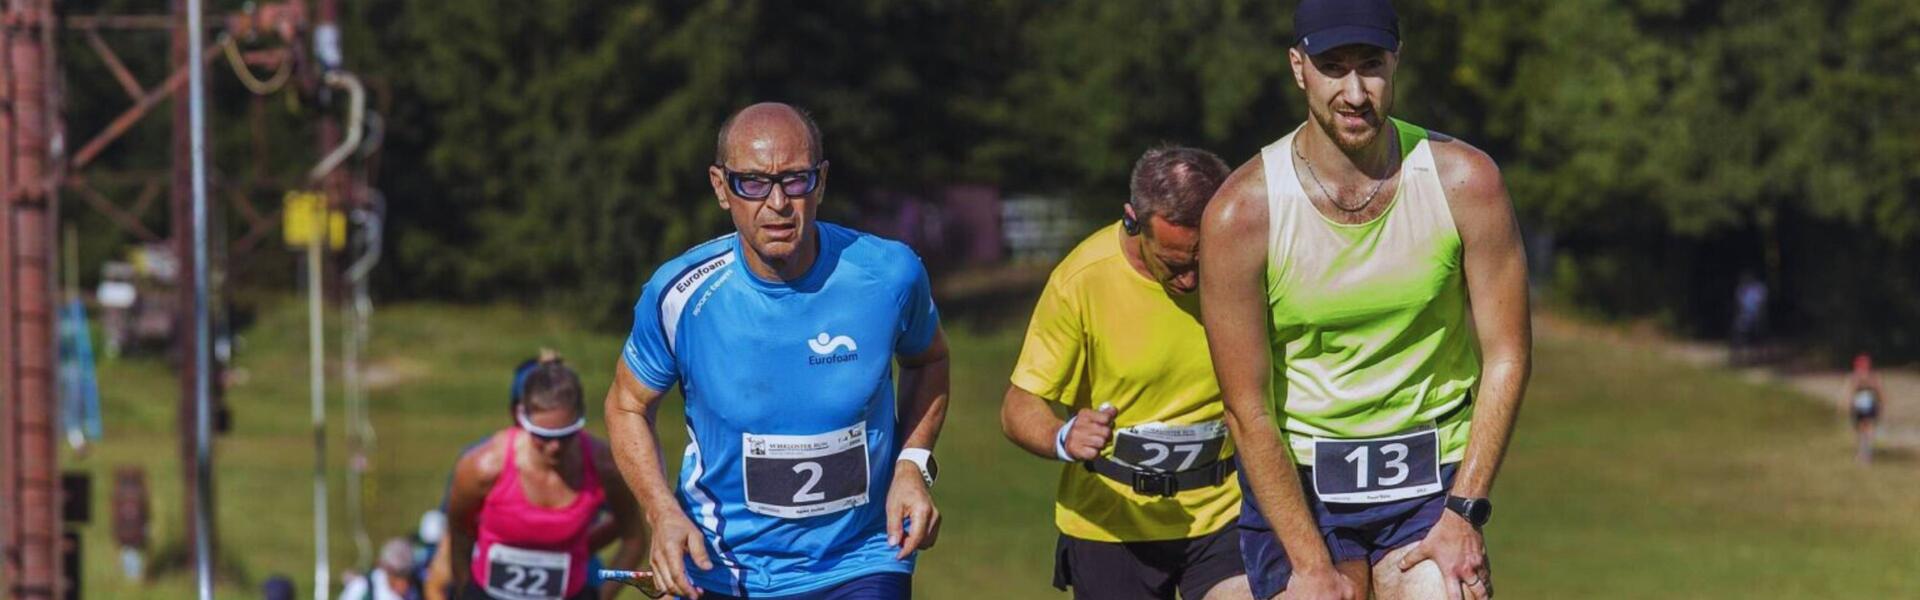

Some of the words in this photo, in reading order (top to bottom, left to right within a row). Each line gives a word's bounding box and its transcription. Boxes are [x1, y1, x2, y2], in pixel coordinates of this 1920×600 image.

[675, 259, 727, 294] Eurofoam
[692, 287, 712, 316] sport
[808, 353, 858, 366] Eurofoam
[1139, 443, 1203, 472] 27
[1344, 443, 1410, 488] 13
[792, 461, 825, 503] 2
[503, 566, 549, 595] 22
